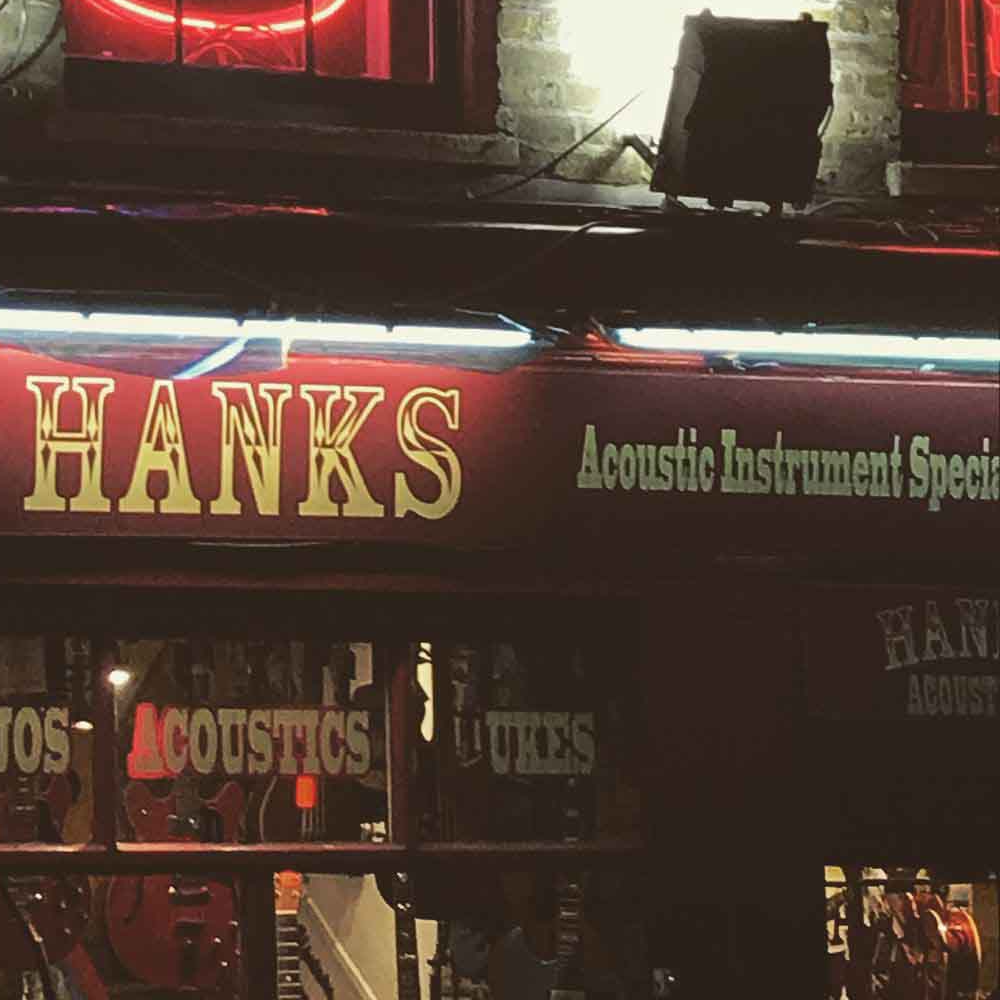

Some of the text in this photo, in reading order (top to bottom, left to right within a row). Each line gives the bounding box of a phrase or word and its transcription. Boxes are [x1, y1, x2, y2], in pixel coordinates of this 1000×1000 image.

[23, 375, 463, 520] HANKS
[576, 423, 716, 493] Acoustic
[719, 428, 903, 497] Instrument
[128, 702, 371, 778] ACOUSTICS
[486, 711, 595, 775] UKES
